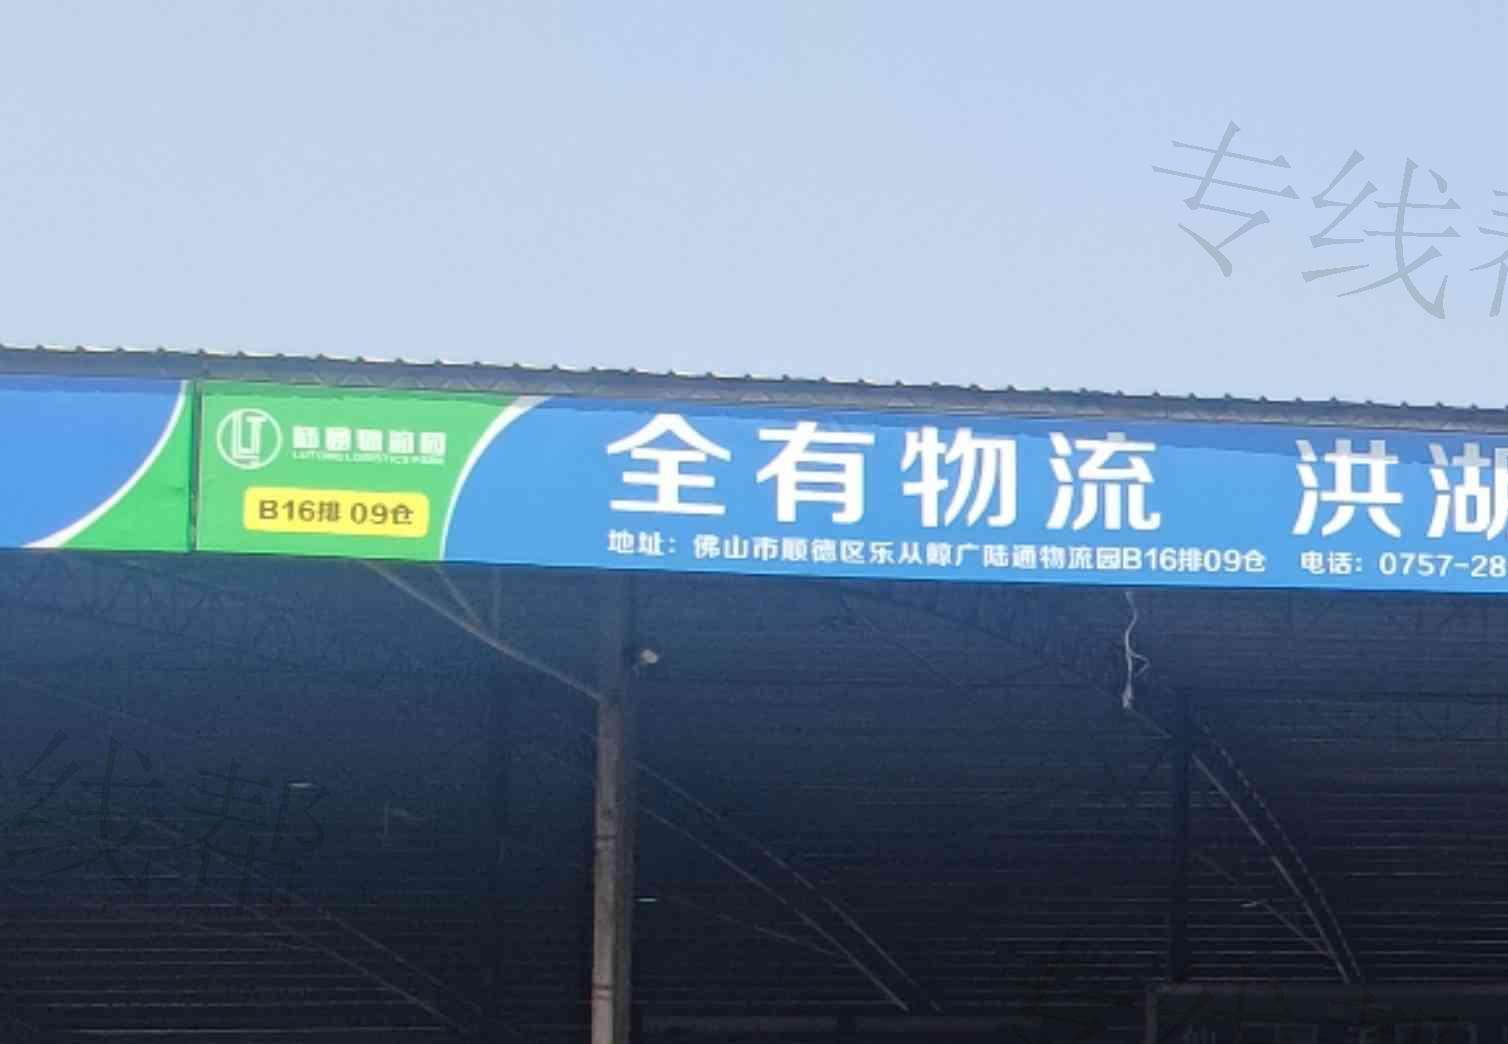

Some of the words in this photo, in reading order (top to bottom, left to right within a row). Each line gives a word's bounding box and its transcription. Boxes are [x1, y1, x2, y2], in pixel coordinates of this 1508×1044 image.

[607, 413, 1160, 530] 全有物流
[350, 502, 414, 525] 09仓
